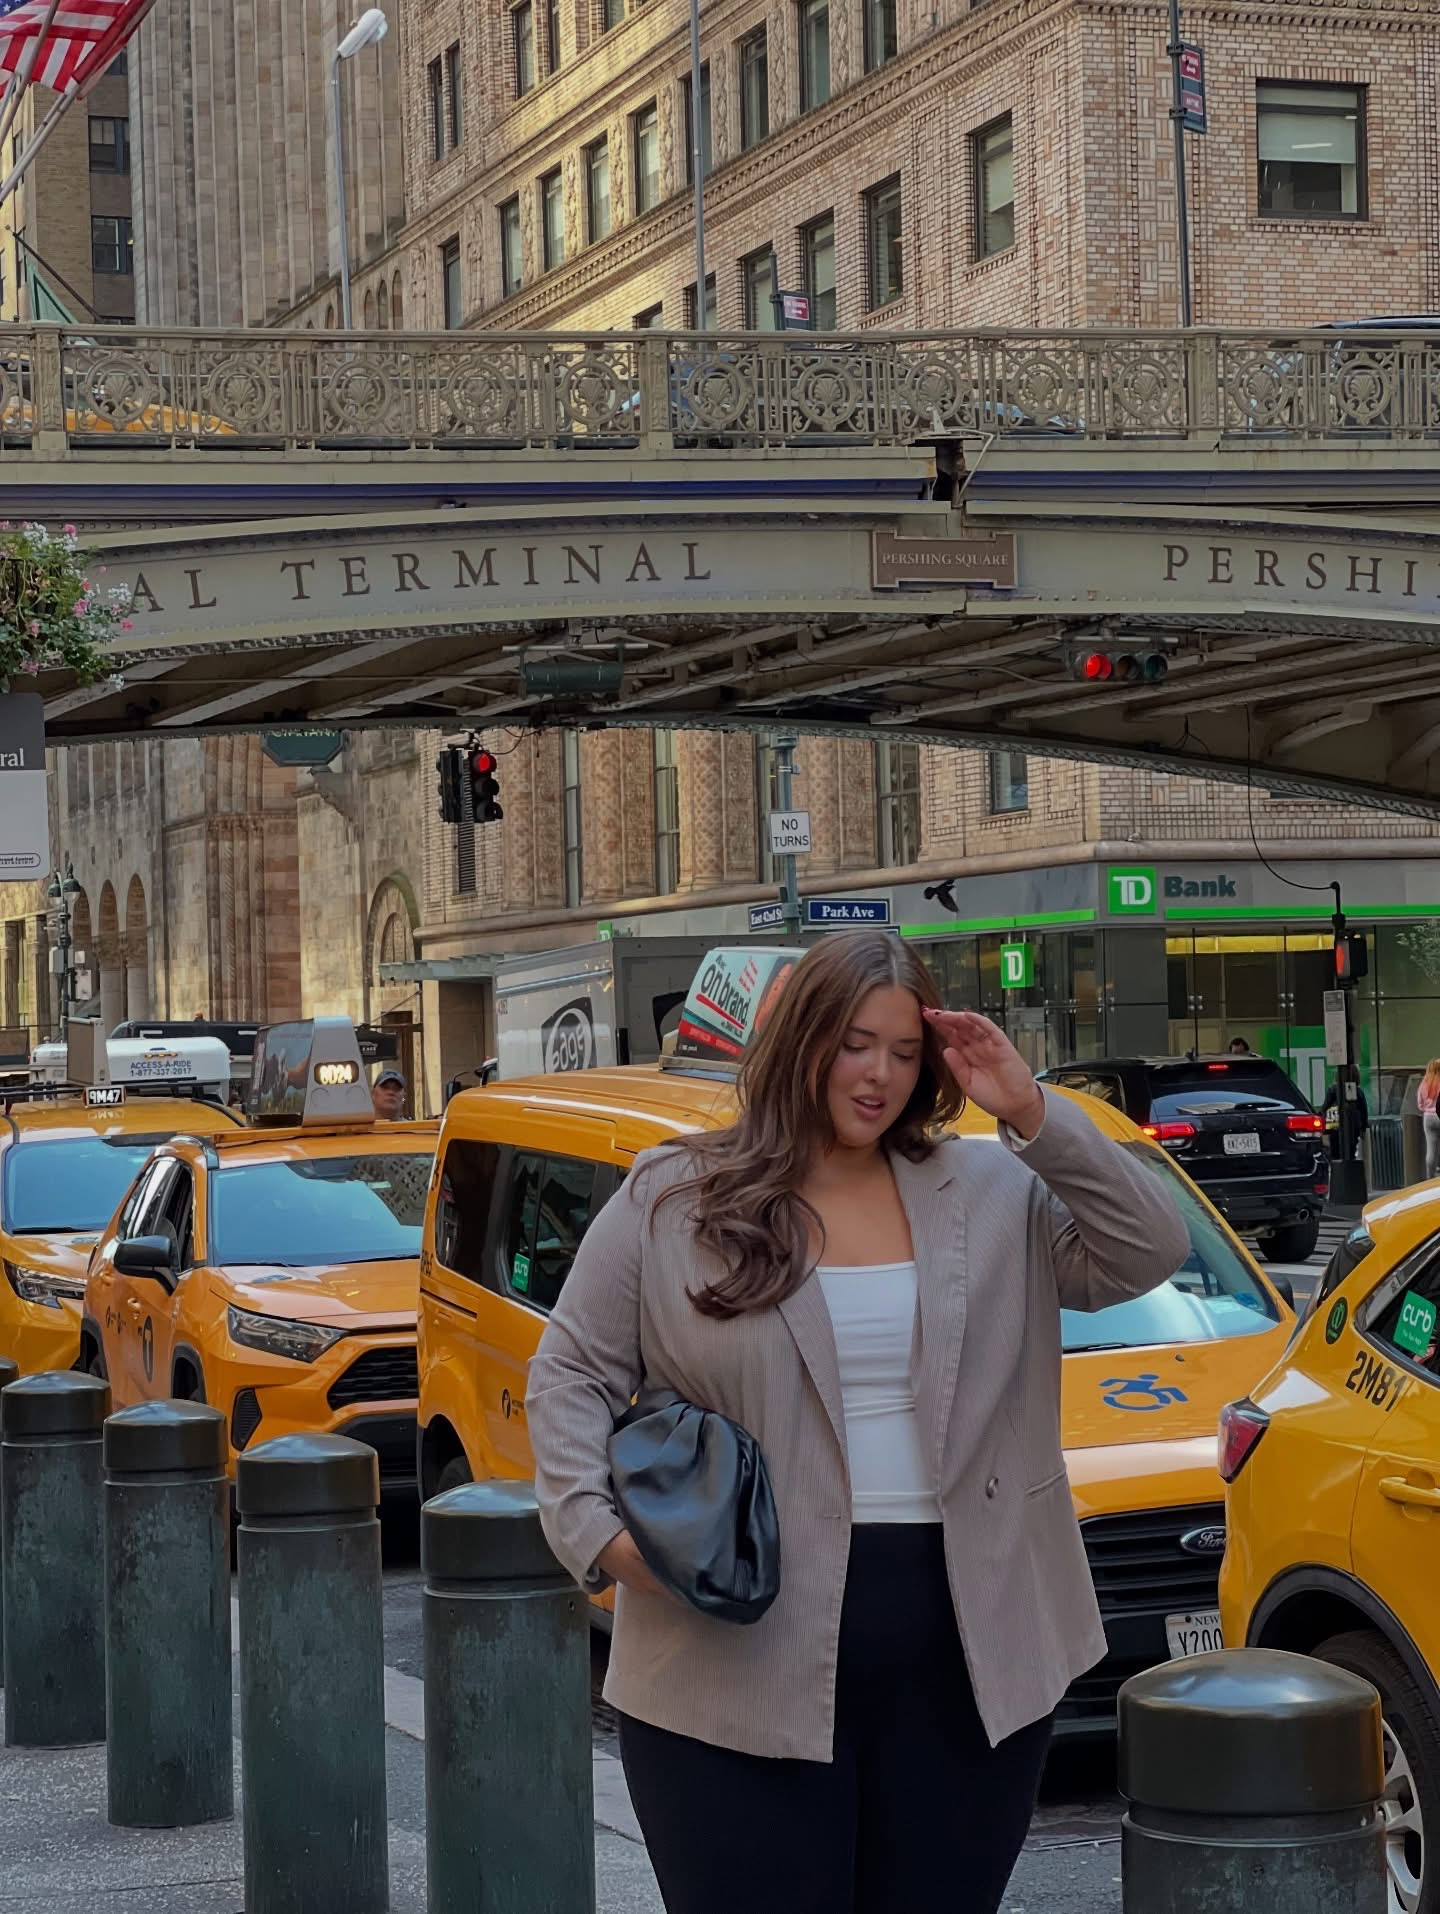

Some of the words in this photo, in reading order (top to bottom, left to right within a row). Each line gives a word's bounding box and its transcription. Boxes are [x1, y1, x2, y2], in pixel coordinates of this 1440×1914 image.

[279, 541, 712, 601] TERMINAL
[881, 552, 952, 566] PERSHING
[955, 553, 1009, 568] SQUARE
[1162, 543, 1440, 599] PERSHI
[781, 818, 799, 831] NO
[773, 834, 809, 848] TURNS
[1112, 875, 1152, 906] TD
[1163, 874, 1237, 898] Bank
[821, 905, 850, 918] Park
[851, 905, 875, 918] Ave
[1004, 950, 1024, 982] TD
[130, 1060, 192, 1069] ACCESS-A-RIDE
[89, 1089, 120, 1104] 9M47
[1402, 1303, 1432, 1333] curb
[1345, 1350, 1407, 1413] 2M81
